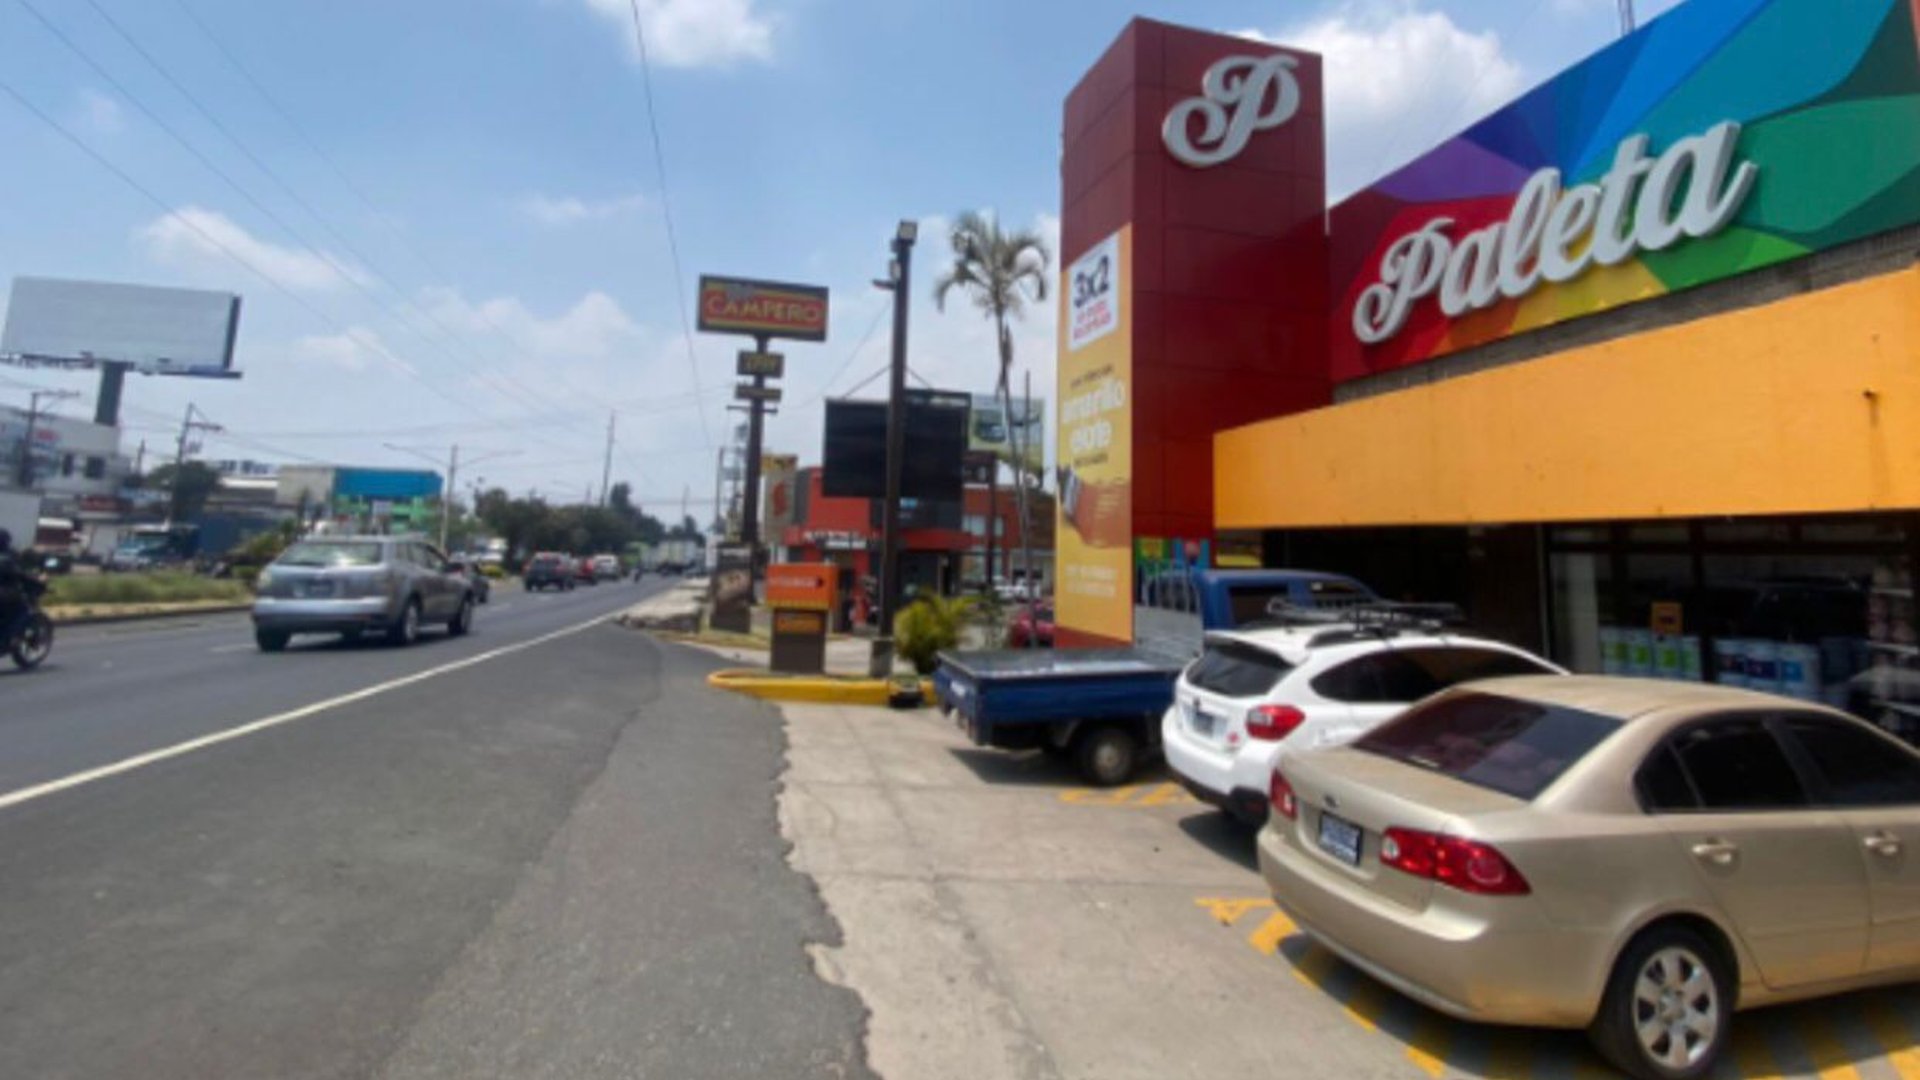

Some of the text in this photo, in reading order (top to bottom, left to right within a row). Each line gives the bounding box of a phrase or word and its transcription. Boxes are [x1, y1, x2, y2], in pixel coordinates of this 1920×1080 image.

[1161, 53, 1301, 168] P
[1352, 120, 1759, 344] Paleta
[705, 294, 819, 323] CAMPERO
[1074, 255, 1109, 309] 3x2
